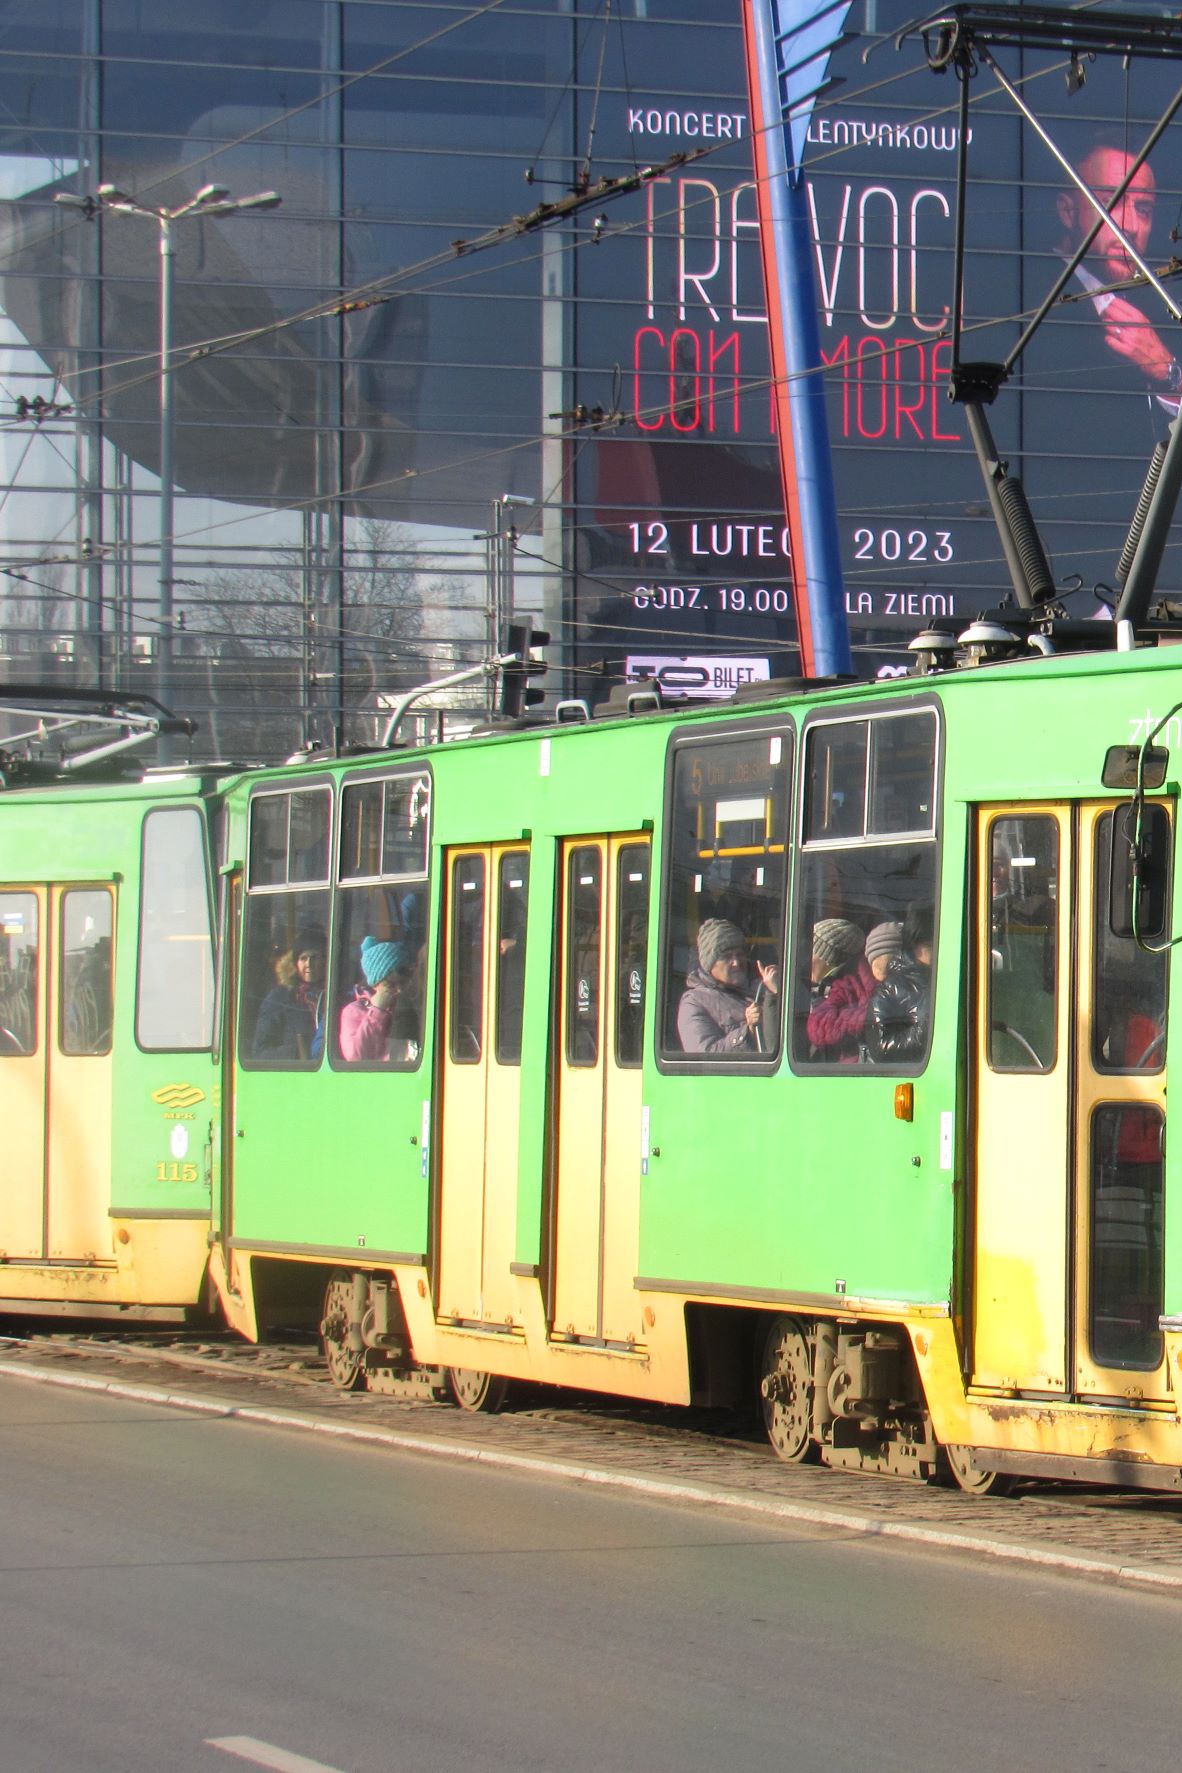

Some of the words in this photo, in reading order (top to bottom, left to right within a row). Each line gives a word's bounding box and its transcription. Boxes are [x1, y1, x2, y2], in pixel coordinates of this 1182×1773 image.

[628, 108, 747, 139] KONCERT
[806, 119, 974, 151] LENTYNKOWY
[806, 183, 964, 332] VOC
[769, 334, 961, 440] MORE
[629, 521, 669, 553] 12
[691, 523, 792, 557] LUTE
[854, 528, 954, 562] 2023
[719, 588, 789, 612] 19.00
[845, 592, 873, 614] LA
[884, 593, 954, 616] ZIEMI
[156, 1161, 199, 1183] 115
